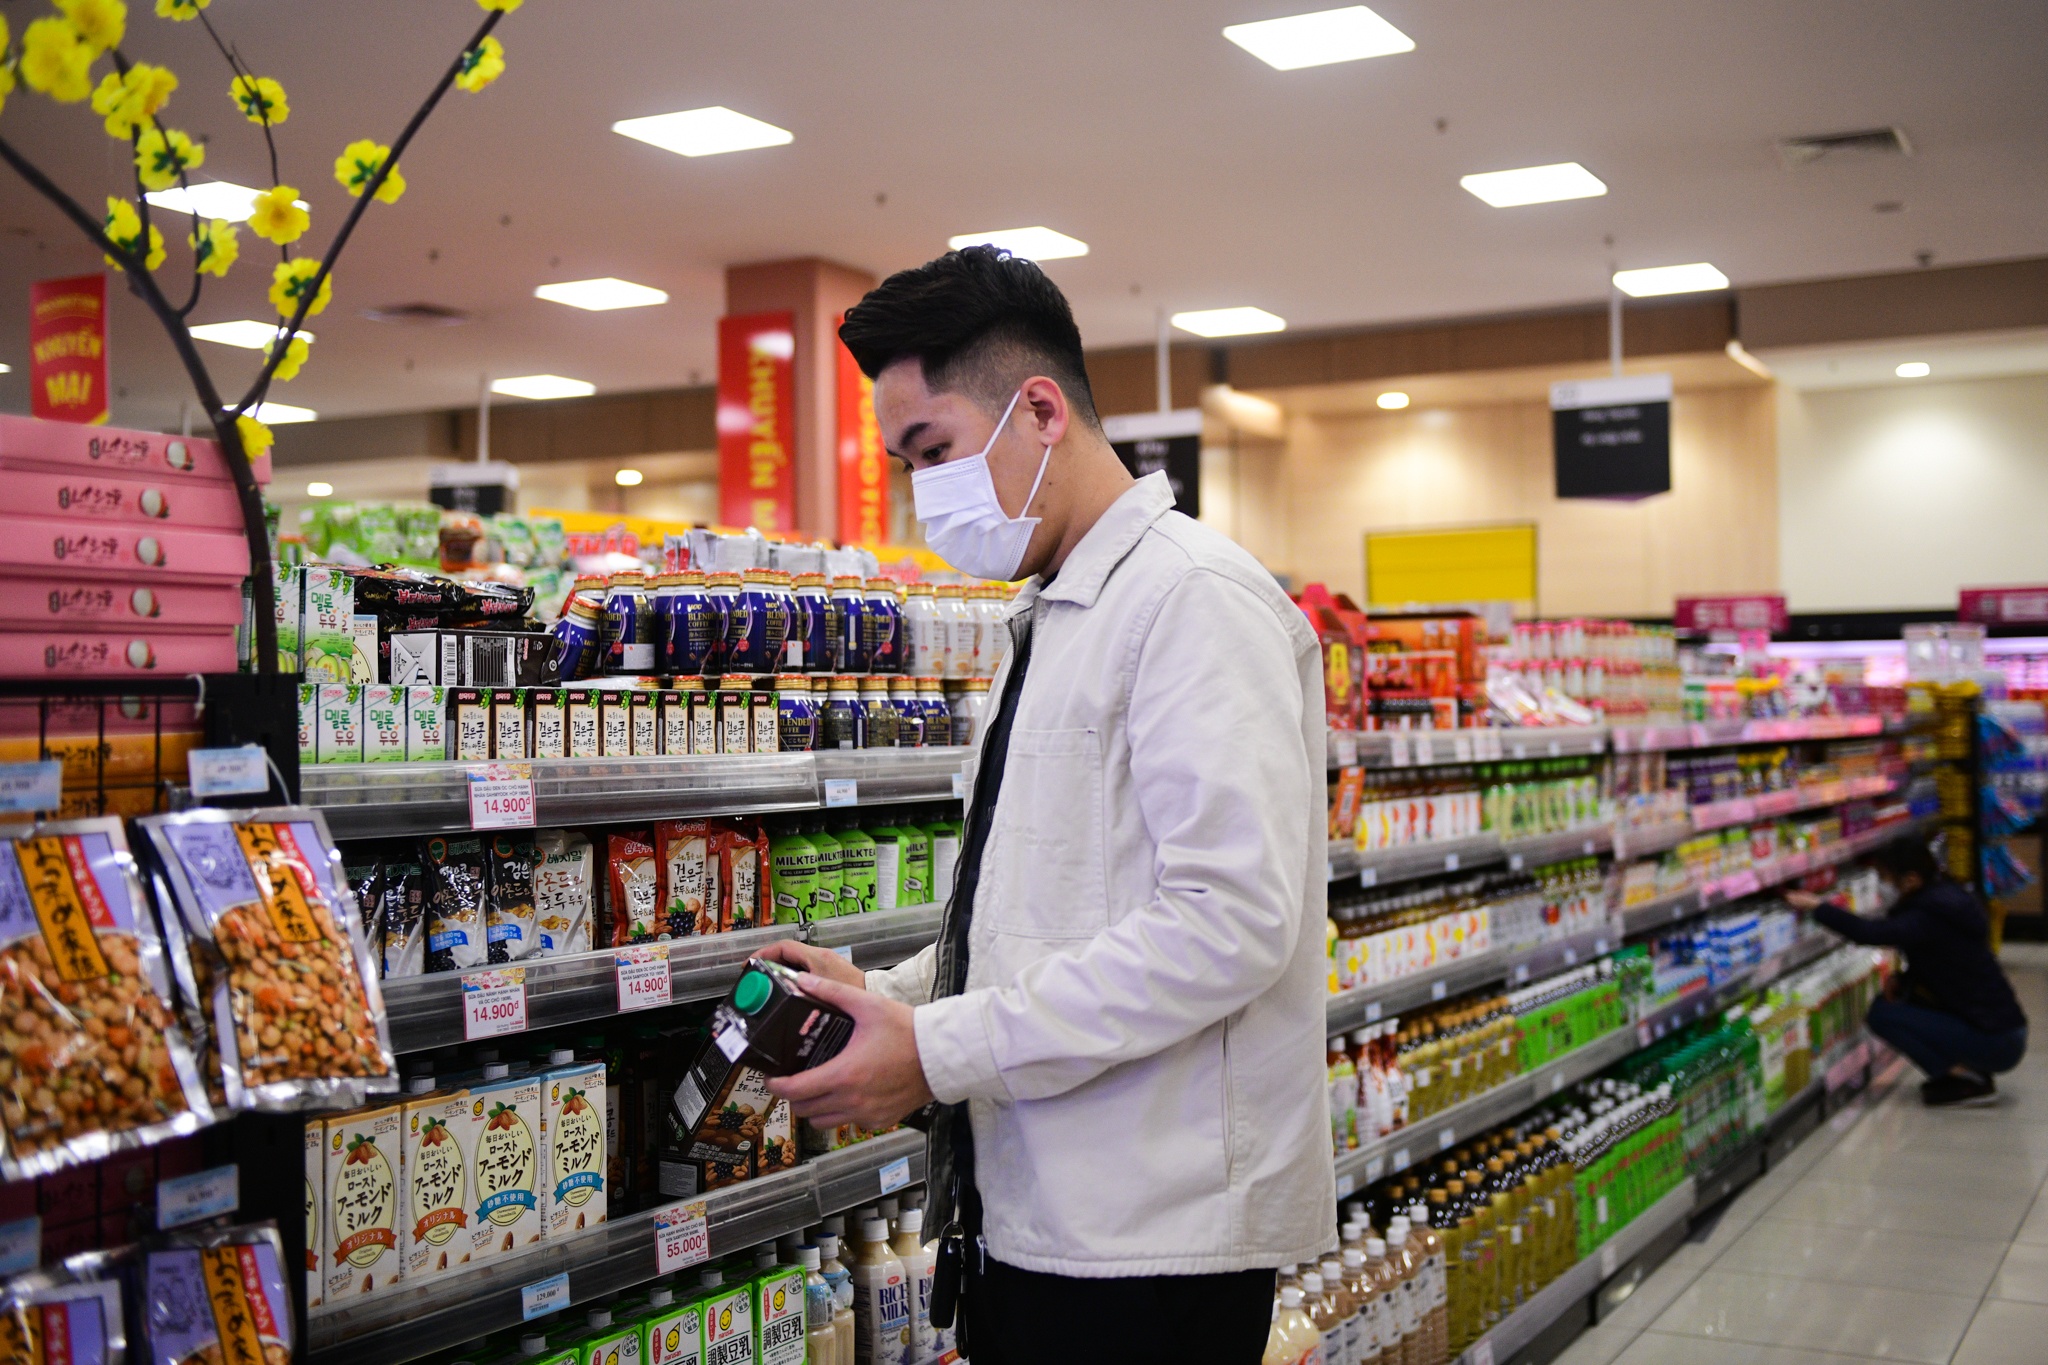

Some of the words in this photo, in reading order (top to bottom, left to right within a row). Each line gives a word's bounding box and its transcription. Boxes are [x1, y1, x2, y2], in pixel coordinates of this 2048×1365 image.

[311, 592, 333, 614] 멜론
[319, 613, 337, 629] 두유
[325, 709, 351, 731] 멜론
[370, 709, 395, 731] 멜론
[413, 709, 437, 731] 멜론
[539, 720, 561, 738] 검은콩
[573, 720, 595, 738] 검은콩
[606, 720, 626, 738] 검은콩
[635, 720, 653, 738] 검은콩
[335, 730, 355, 747] 두유
[379, 730, 399, 746] 두유
[423, 730, 440, 746] 두유
[461, 721, 486, 739] 검은콩
[498, 721, 521, 738] 검은콩
[484, 796, 531, 814] 14.900đ
[547, 850, 583, 864] 베지밀
[818, 850, 843, 863] MILKTE
[503, 861, 530, 880] 검은
[628, 975, 668, 995] 14.900đ
[473, 1000, 519, 1023] 14.900đ
[561, 1114, 592, 1128] 毎日おいしい
[485, 1130, 523, 1144] 毎日おいしい
[563, 1124, 587, 1139] ロースト
[420, 1146, 453, 1160] 毎日おいしい
[489, 1140, 518, 1155] ロースト
[555, 1132, 600, 1160] アーモンド
[344, 1164, 382, 1179] 毎日おいしい
[423, 1156, 448, 1172] ロースト
[479, 1148, 532, 1177] アーモンド
[562, 1152, 592, 1173] ミルク
[347, 1175, 377, 1191] ロースト
[415, 1164, 462, 1195] アーモンド
[488, 1169, 524, 1192] ミルク
[562, 1173, 593, 1191] 砂糖不使用
[337, 1182, 392, 1216] アーモンド
[422, 1186, 455, 1210] ミルク
[487, 1192, 525, 1209] 砂糖不使用
[346, 1205, 383, 1231] ミルク
[422, 1212, 456, 1228] オリジナル
[346, 1233, 384, 1250] オリジナル
[667, 1232, 706, 1258] 55.000đ
[879, 1284, 907, 1306] RICE
[879, 1301, 909, 1323] MILK
[763, 1315, 804, 1351] 調製豆乳
[707, 1334, 752, 1365] 調製豆乳
